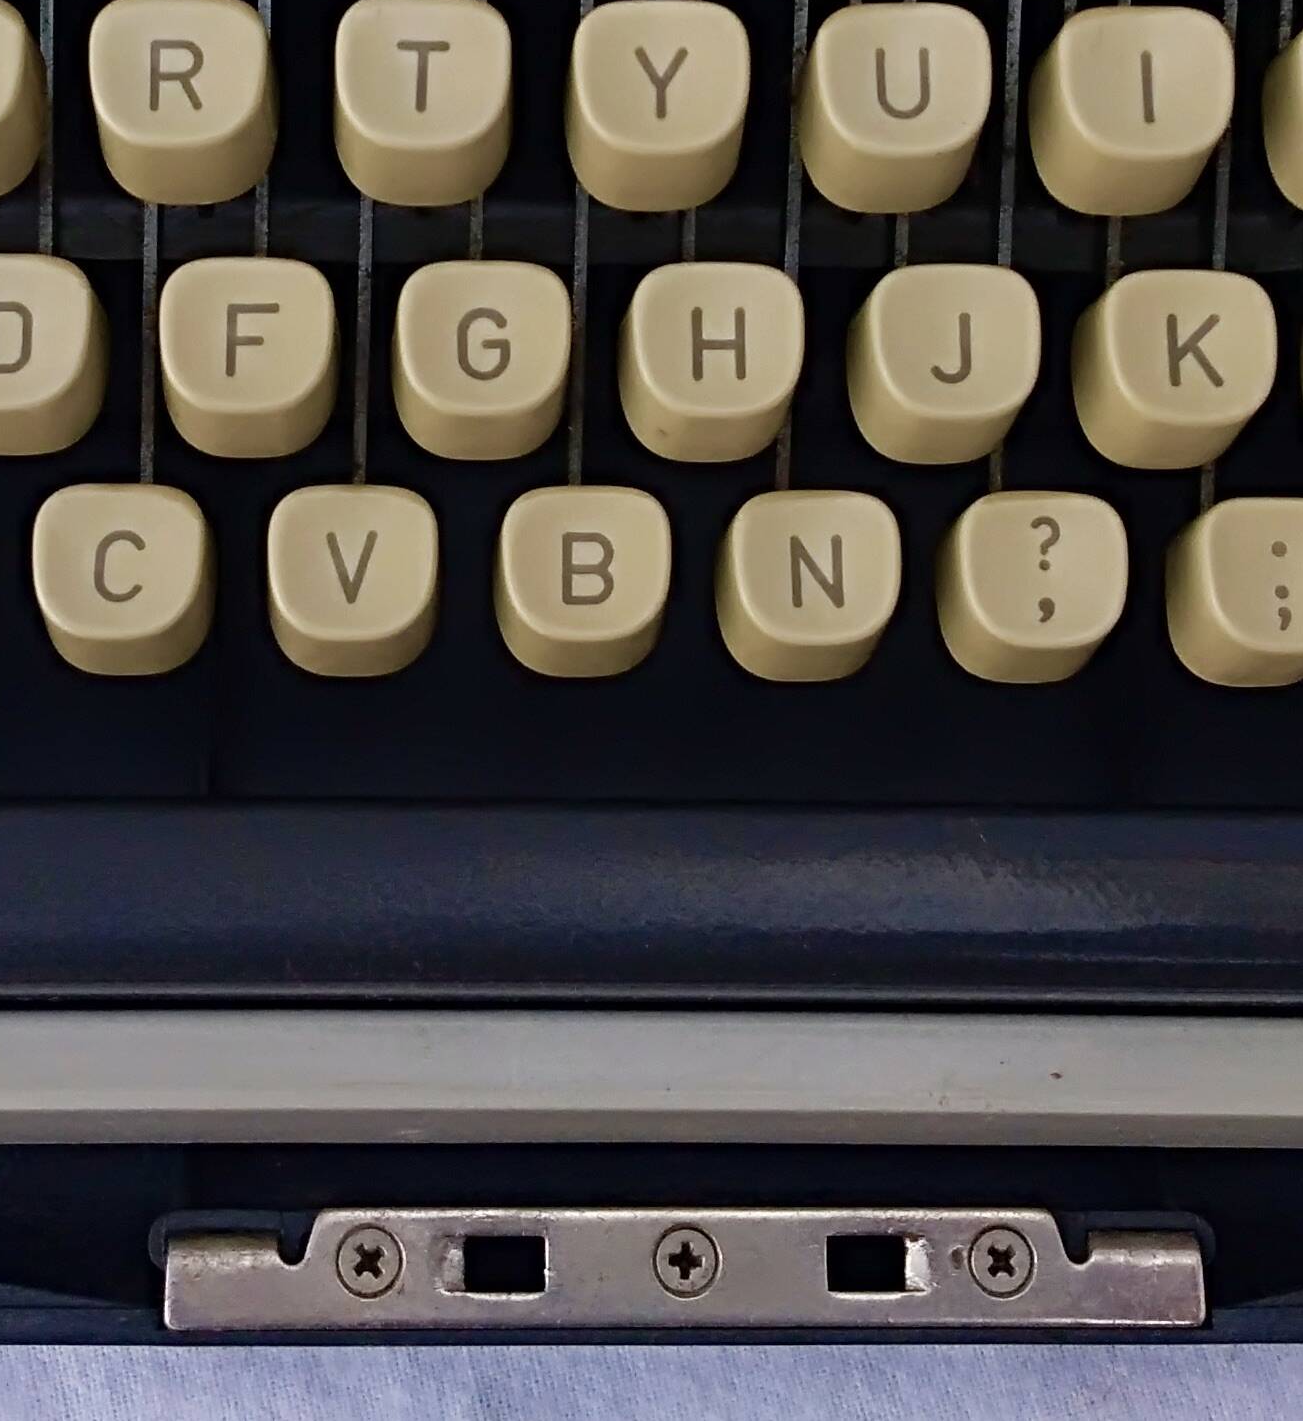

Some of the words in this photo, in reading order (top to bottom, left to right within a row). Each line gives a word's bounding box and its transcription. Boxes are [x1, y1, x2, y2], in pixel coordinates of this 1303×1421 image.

[149, 39, 205, 112] R
[396, 39, 451, 114] T
[634, 46, 689, 121] Y
[875, 47, 931, 120] U
[1140, 49, 1156, 125] I
[224, 302, 281, 379] F
[456, 307, 512, 382] G
[690, 306, 747, 382] H
[930, 312, 972, 385] J
[1166, 313, 1225, 389] K
[93, 529, 147, 604] C
[325, 530, 378, 605] V
[561, 531, 615, 606] B
[789, 534, 845, 609] N
[1030, 515, 1061, 572] ?
[1274, 584, 1293, 632] ;
